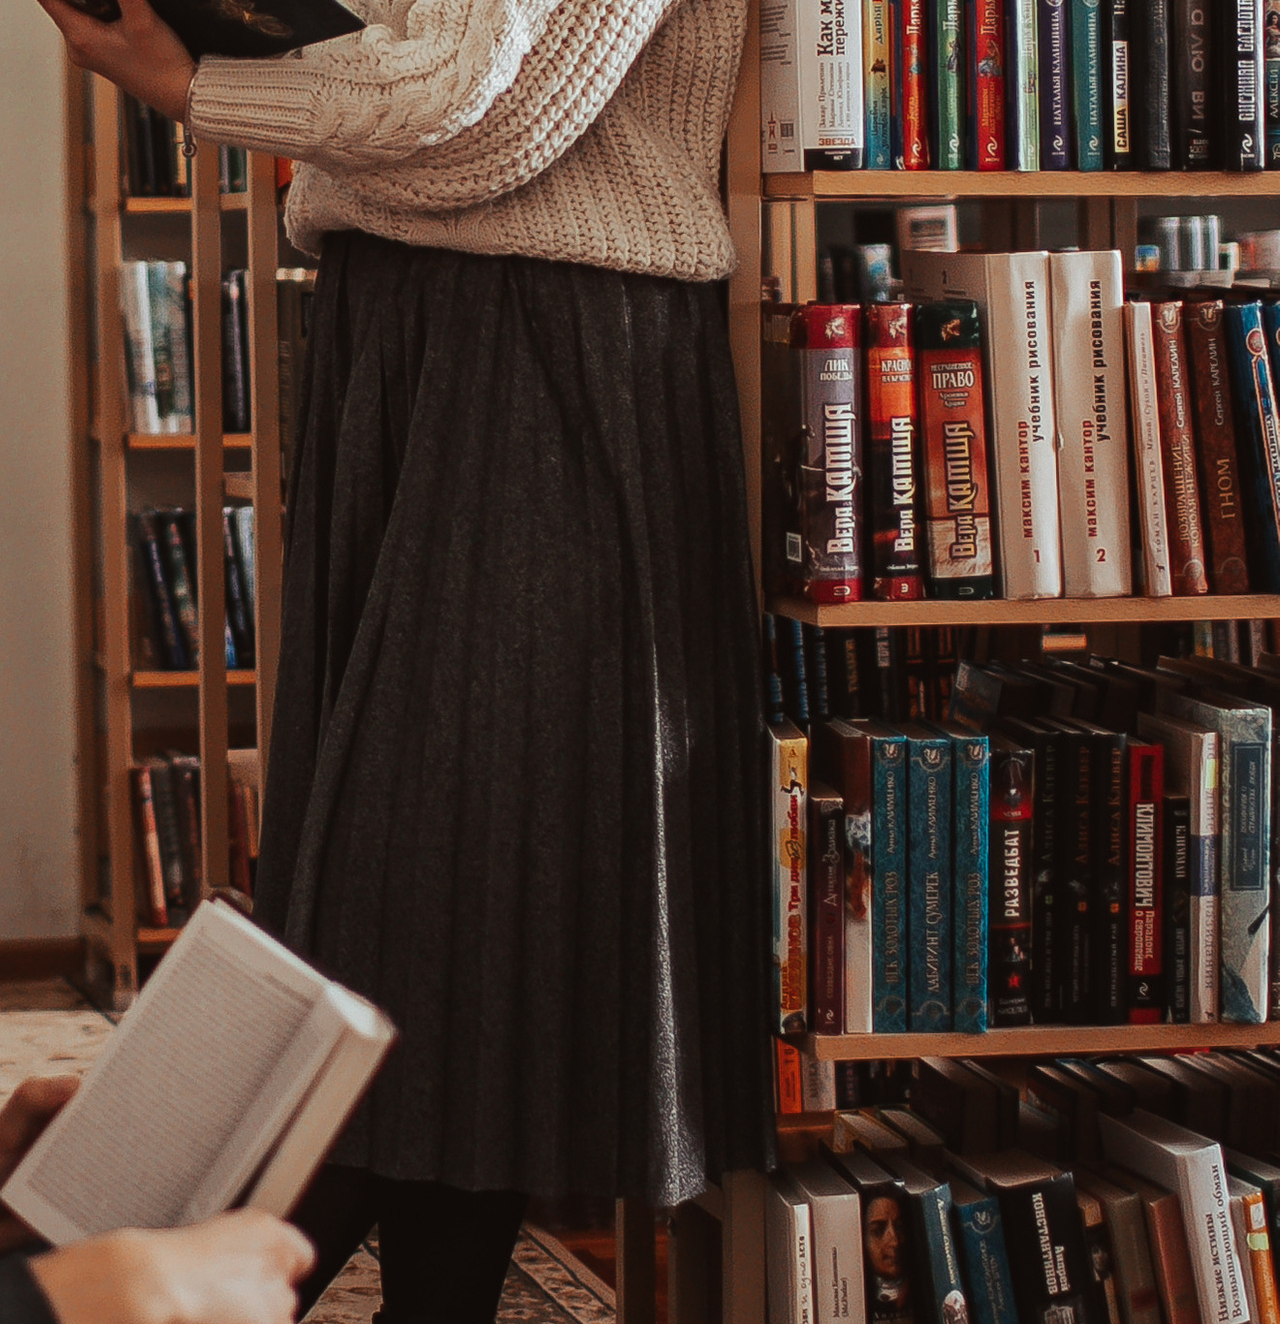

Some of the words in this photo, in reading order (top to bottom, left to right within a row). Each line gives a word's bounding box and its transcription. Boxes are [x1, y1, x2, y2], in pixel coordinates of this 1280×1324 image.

[817, 17, 834, 56] Как
[1052, 11, 1060, 75] КАЛИНИНА
[1088, 11, 1096, 75] КАЛИНИНА
[1116, 46, 1126, 100] КАЛИНА
[1053, 76, 1061, 126] НАТАЛЬЯ
[1089, 76, 1097, 126] НАТАЛЬЯ
[1117, 108, 1128, 148] САША
[818, 137, 857, 146] ЗВЕЗДА
[1024, 280, 1042, 369] рисования
[1090, 280, 1108, 369] рисования
[820, 372, 852, 381] ПОБЕДЫ
[825, 358, 848, 371] ЛИК
[932, 371, 974, 390] ПРАВО
[1170, 339, 1182, 389] КАРЕЛИН
[1211, 338, 1221, 388] КАРЕЛИН
[1028, 374, 1044, 442] учебник
[1092, 374, 1111, 443] учебник
[1176, 392, 1185, 428] Сергей
[1214, 390, 1224, 426] Сергей
[1018, 419, 1030, 474] кантор
[1082, 419, 1095, 473] кантор
[1021, 478, 1034, 539] максим
[1086, 478, 1098, 538] максим
[1172, 443, 1190, 542] ВОЗВРАЩЕНИЕ
[1217, 458, 1236, 519] ГНОМ
[1188, 496, 1200, 548] КОРОЛЯ
[1033, 549, 1041, 562] 1
[1096, 549, 1106, 562] 2
[886, 770, 895, 828] КЛИМЕНКО
[927, 776, 936, 833] КЛИМЕНКО
[887, 829, 895, 854] Анна
[928, 834, 936, 859] Анна
[1135, 802, 1155, 908] КЛИМОНТОВИЧ
[789, 888, 799, 912] Три
[885, 871, 898, 894] РОЗ
[926, 871, 943, 925] СУМЕРЕК
[1004, 829, 1020, 918] РАЗВЕДБАТ
[885, 898, 898, 956] ЗОЛОТЫХ
[1144, 910, 1155, 959] Парадокс
[926, 928, 940, 993] ЛАБИРИНТ
[1212, 1164, 1226, 1208] обман
[1032, 1192, 1058, 1295] КОНСТАНТИНОВ
[1206, 1212, 1220, 1266] истины
[1220, 1210, 1242, 1318] Возвышающий
[1054, 1245, 1070, 1292] Андрей
[1212, 1268, 1229, 1322] Низкие
